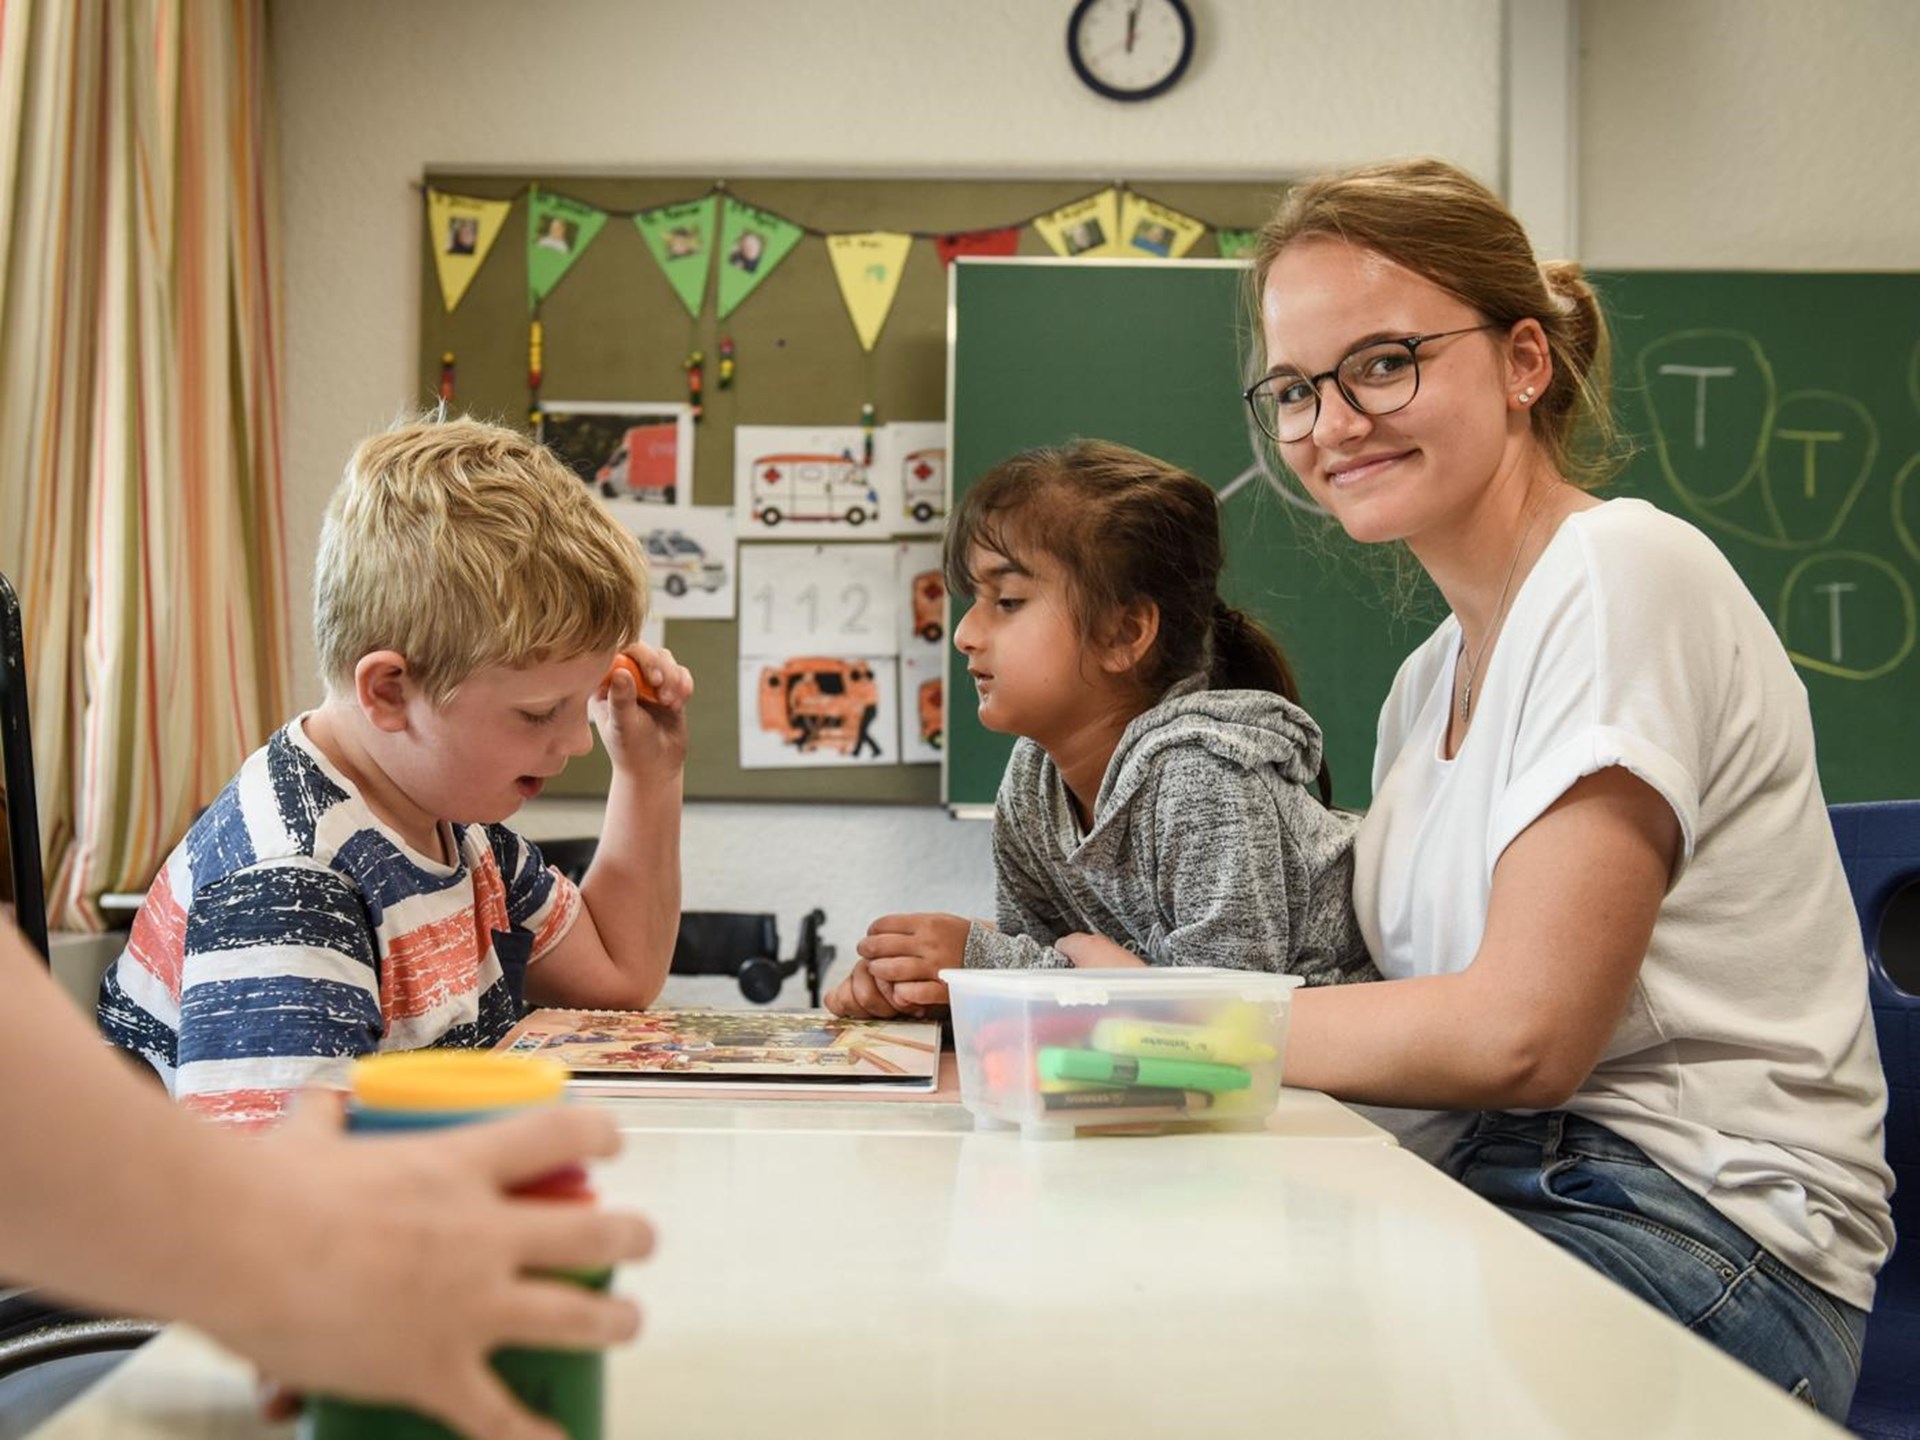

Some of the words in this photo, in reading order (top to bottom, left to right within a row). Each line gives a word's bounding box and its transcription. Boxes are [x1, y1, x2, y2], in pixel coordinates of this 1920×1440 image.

[1658, 364, 1737, 448] T
[1776, 429, 1844, 498] T
[1814, 581, 1857, 662] T
